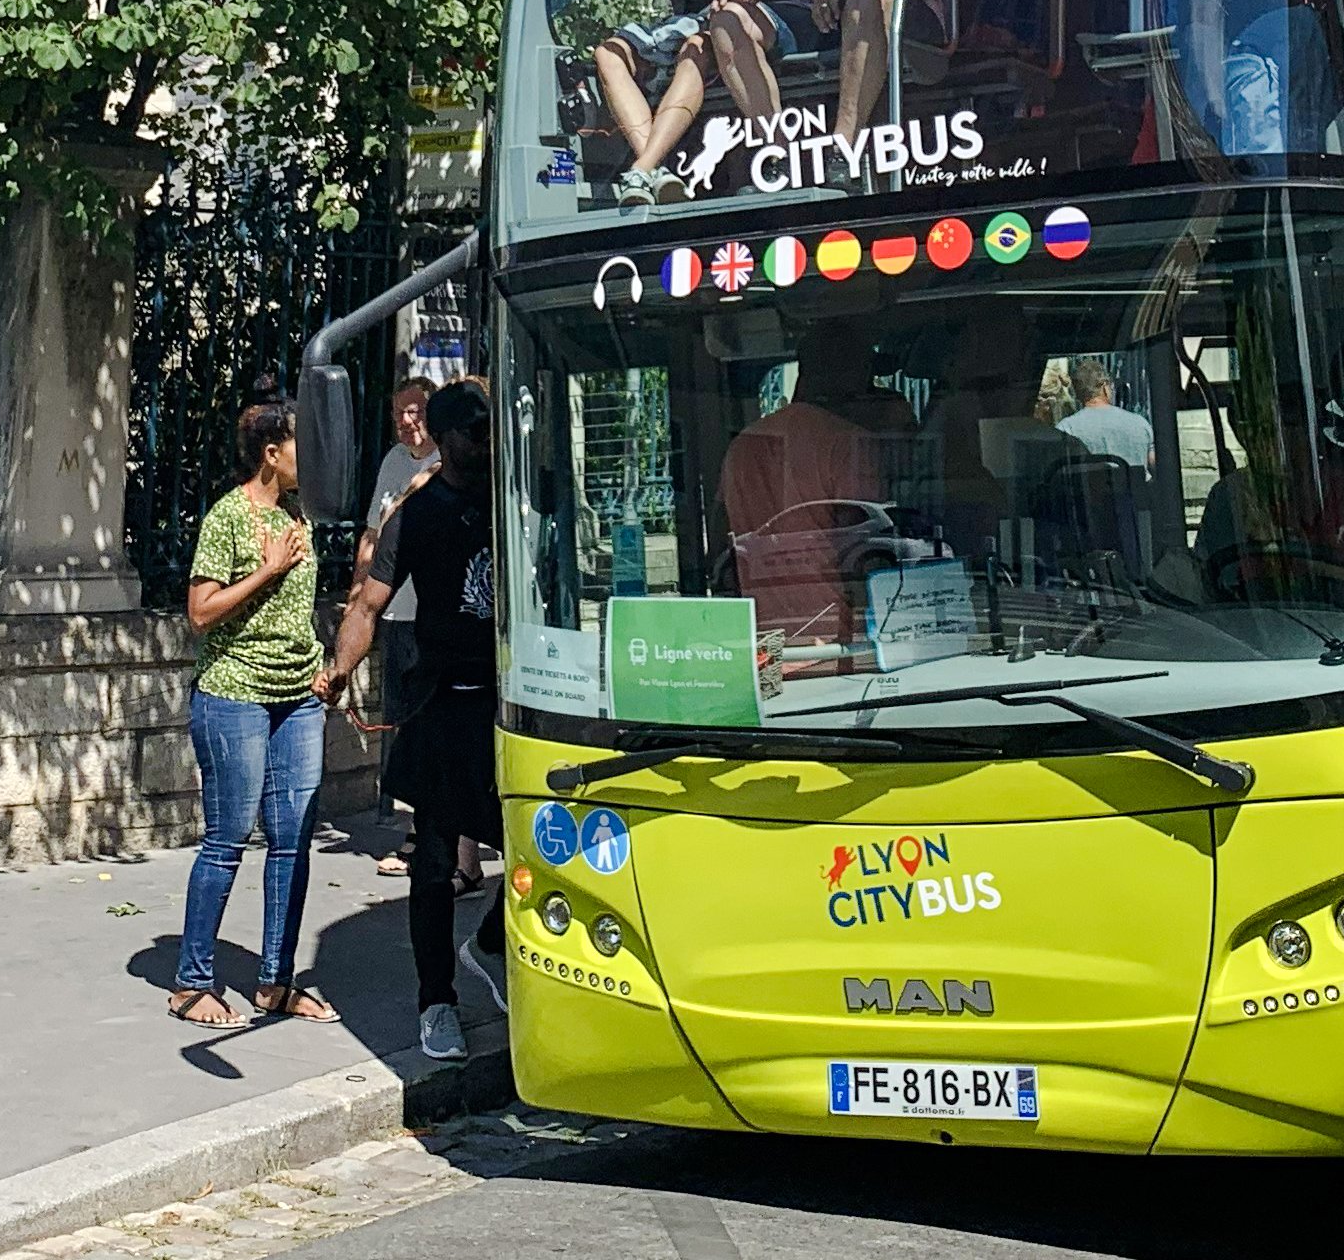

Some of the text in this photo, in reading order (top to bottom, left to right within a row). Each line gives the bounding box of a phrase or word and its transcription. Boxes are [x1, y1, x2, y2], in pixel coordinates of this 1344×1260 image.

[743, 103, 827, 148] LYON
[750, 111, 984, 193] CITYBUS
[904, 165, 958, 187] Visitez
[961, 163, 995, 181] notre
[999, 156, 1036, 178] ville
[654, 644, 733, 664] Ligne verte
[856, 832, 951, 878] LYON
[828, 871, 1002, 928] CITYBUS
[843, 976, 995, 1018] MAN
[836, 1090, 845, 1104] F
[852, 1065, 1013, 1108] FE-816-BX
[1018, 1096, 1036, 1115] 69
